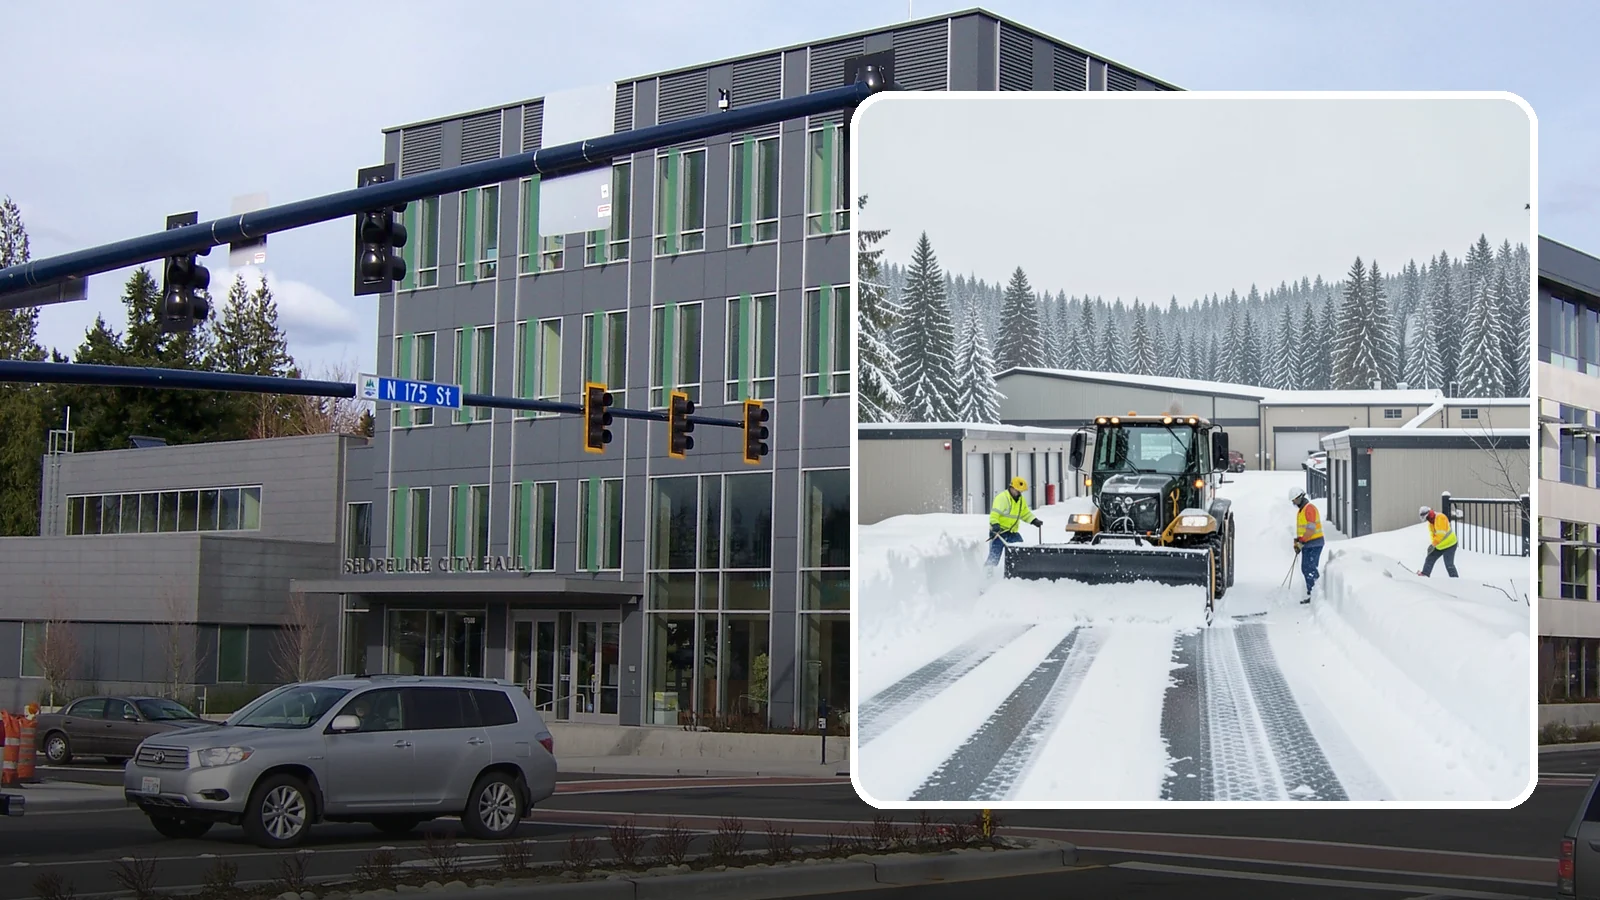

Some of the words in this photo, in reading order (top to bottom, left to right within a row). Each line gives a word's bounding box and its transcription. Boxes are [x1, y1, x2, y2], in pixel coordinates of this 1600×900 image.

[387, 380, 396, 400] N
[404, 382, 428, 403] 175
[436, 386, 452, 406] St
[344, 556, 432, 574] SHORELINE
[438, 556, 475, 573] CITY
[483, 555, 526, 572] HALL
